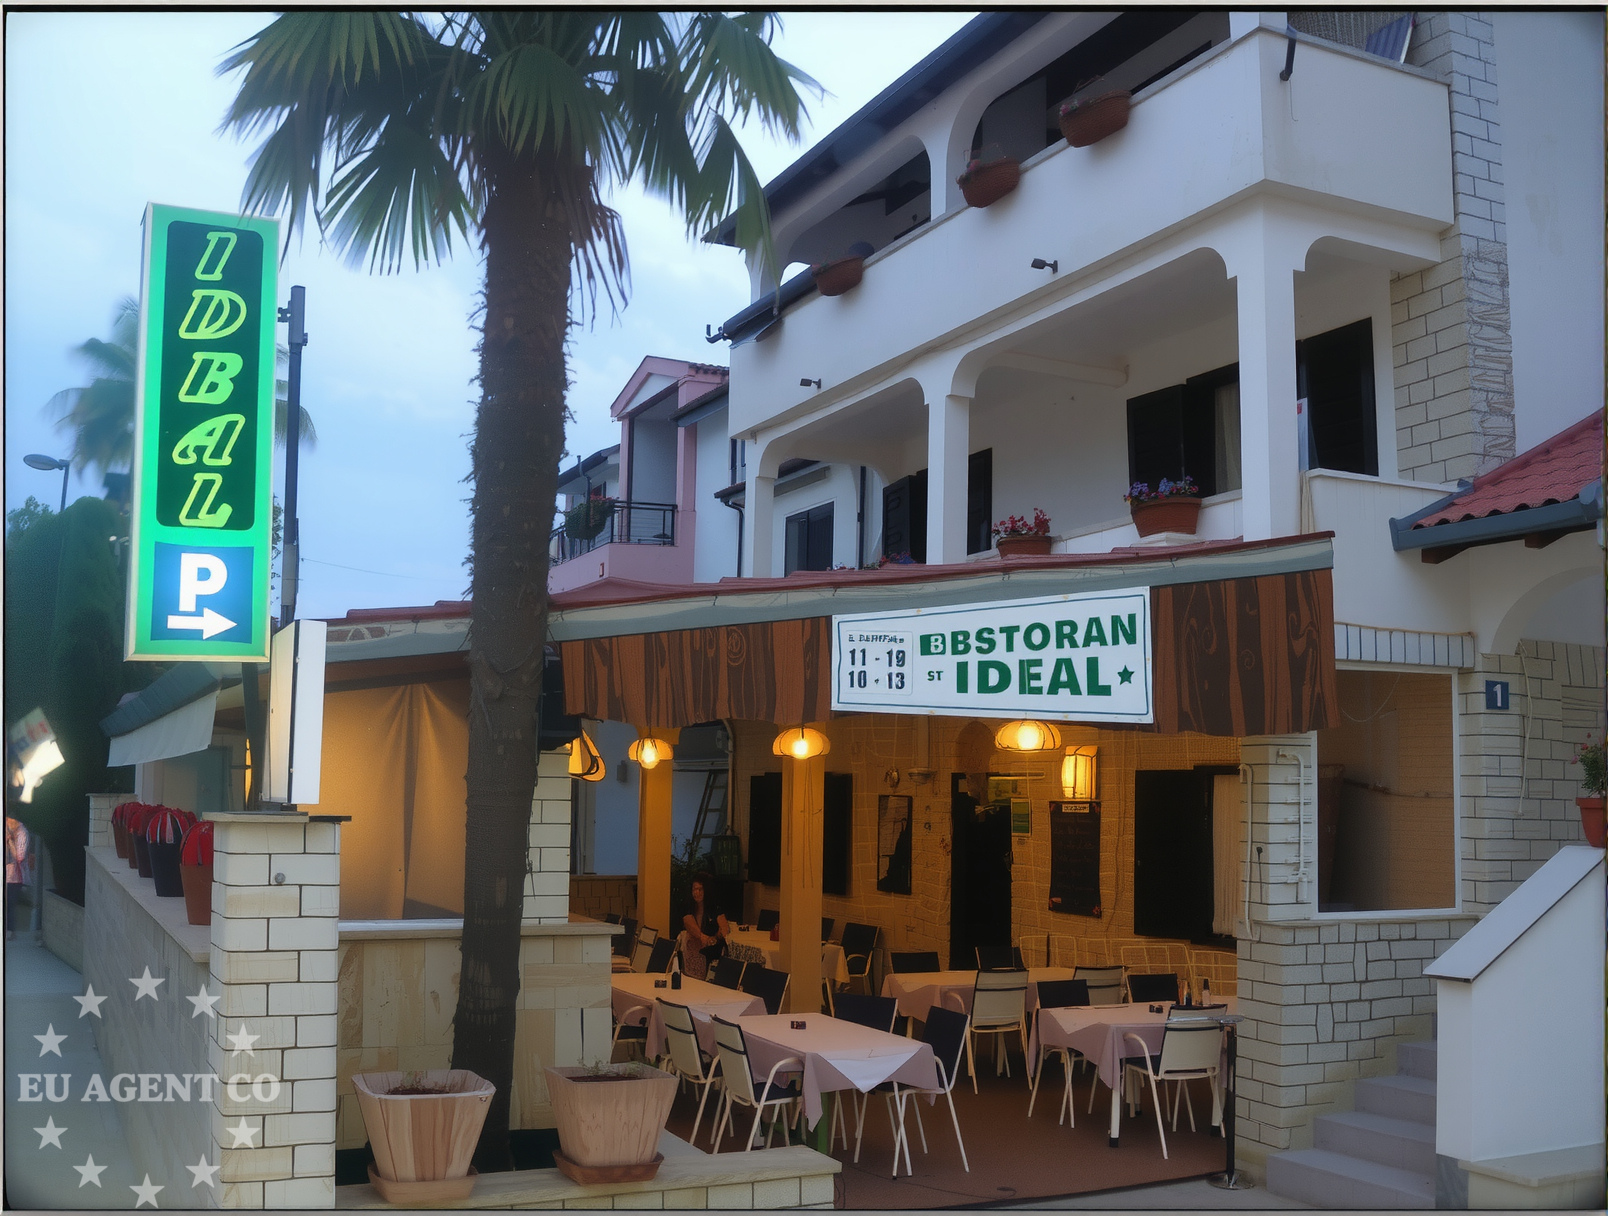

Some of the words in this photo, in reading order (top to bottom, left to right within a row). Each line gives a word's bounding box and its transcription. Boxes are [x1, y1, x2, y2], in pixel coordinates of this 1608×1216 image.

[179, 552, 228, 613] P
[848, 648, 866, 666] 11
[848, 670, 867, 688] 10
[927, 670, 944, 682] ST
[956, 657, 1112, 697] IDEAL
[1492, 683, 1502, 707] 1
